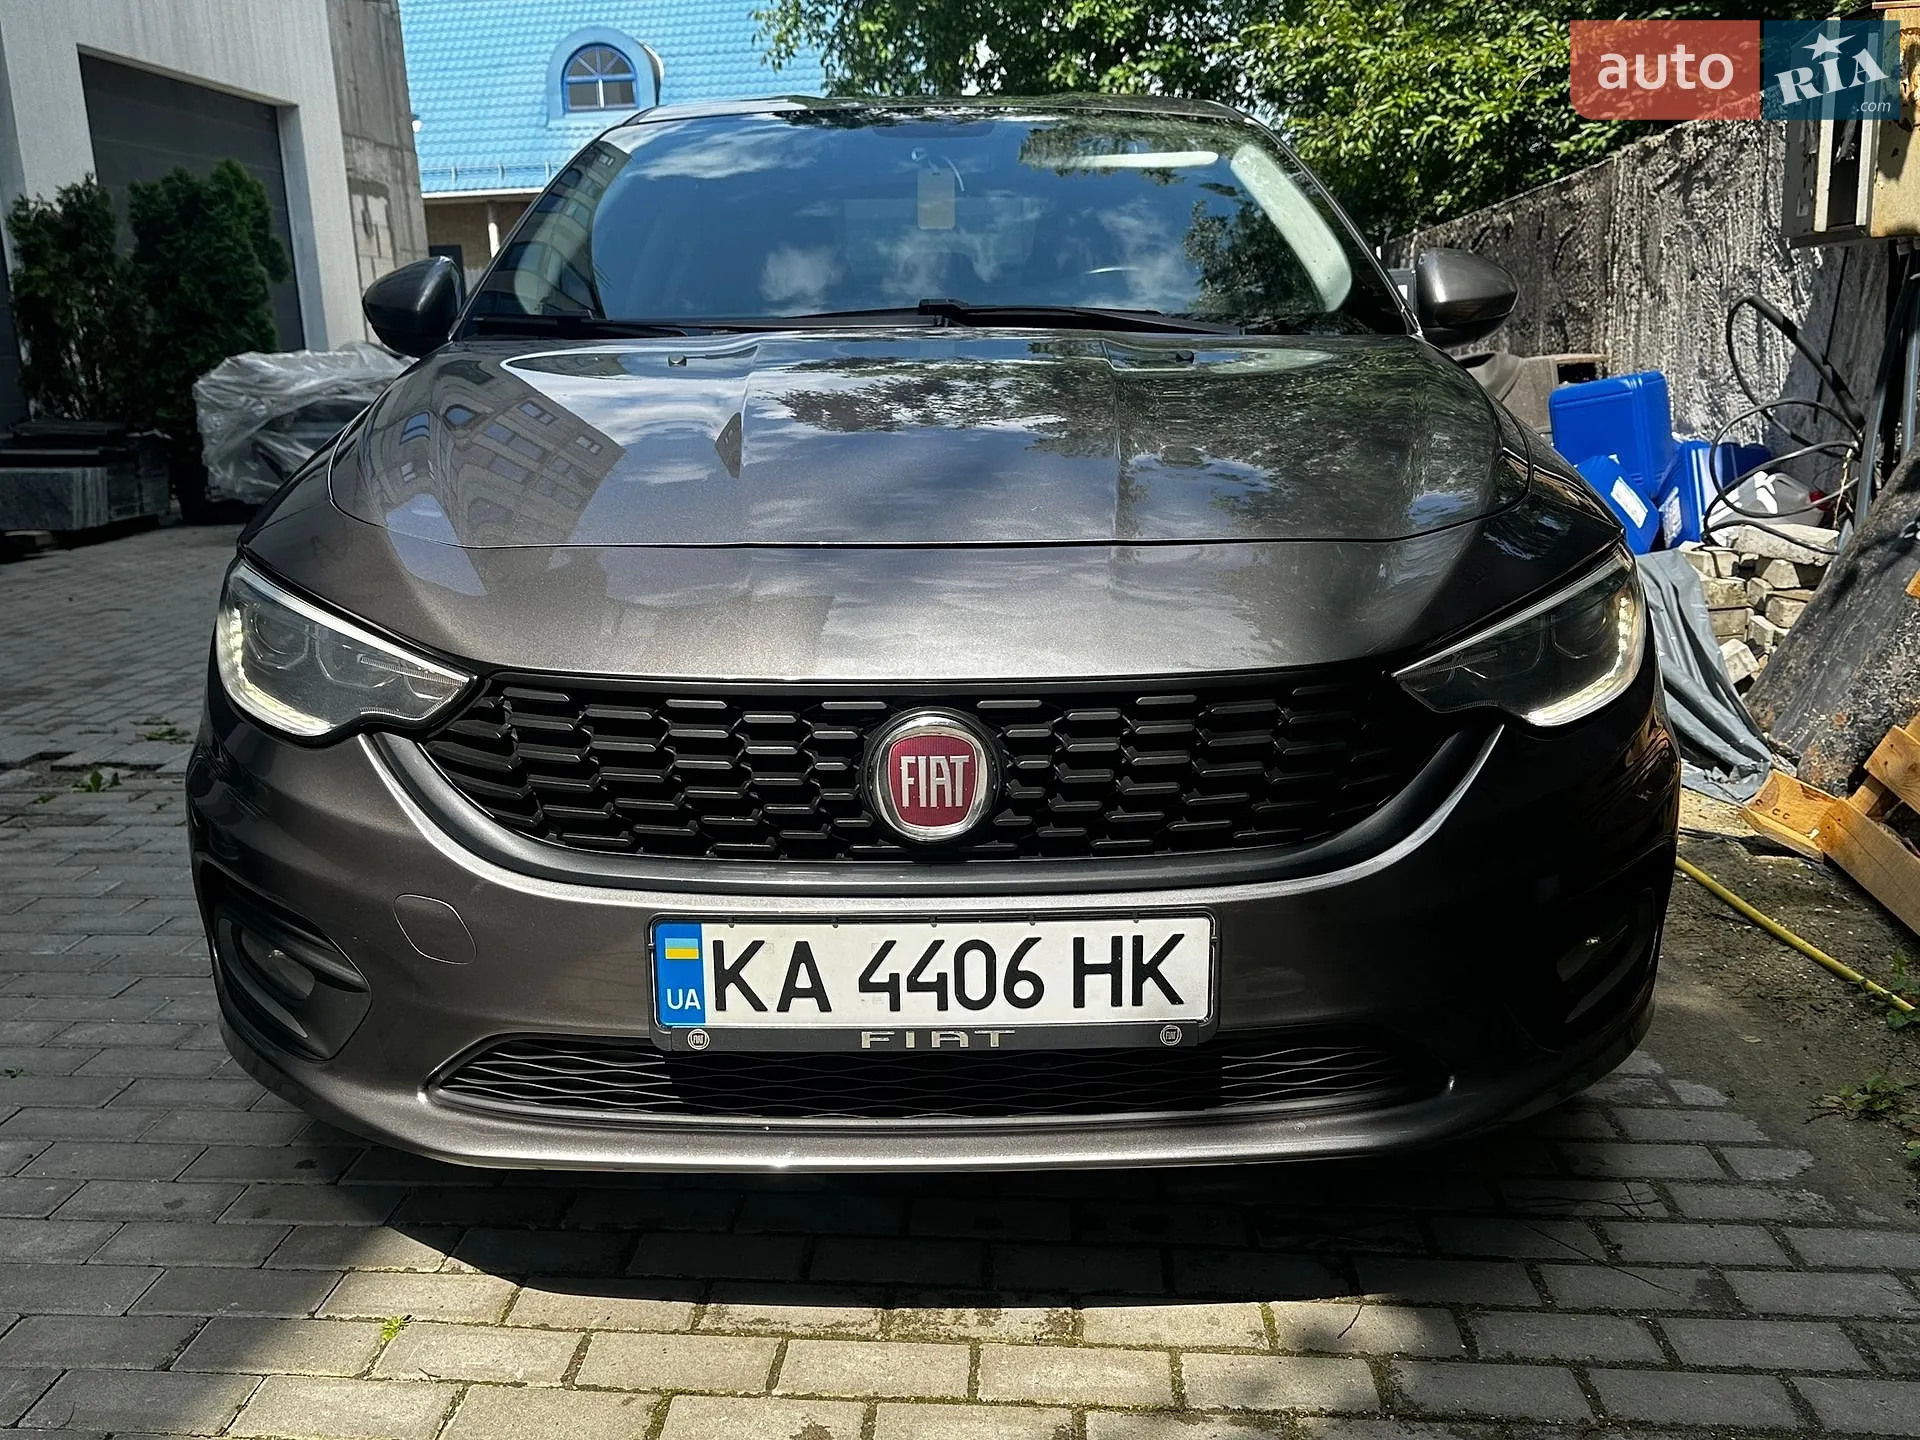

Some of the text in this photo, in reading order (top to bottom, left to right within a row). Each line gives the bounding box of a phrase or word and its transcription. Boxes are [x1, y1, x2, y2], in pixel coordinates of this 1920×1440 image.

[900, 755, 970, 807] FIAT
[712, 933, 1185, 1012] KA 4406 HK
[666, 988, 702, 1010] UA
[861, 1030, 1016, 1049] FIAT
